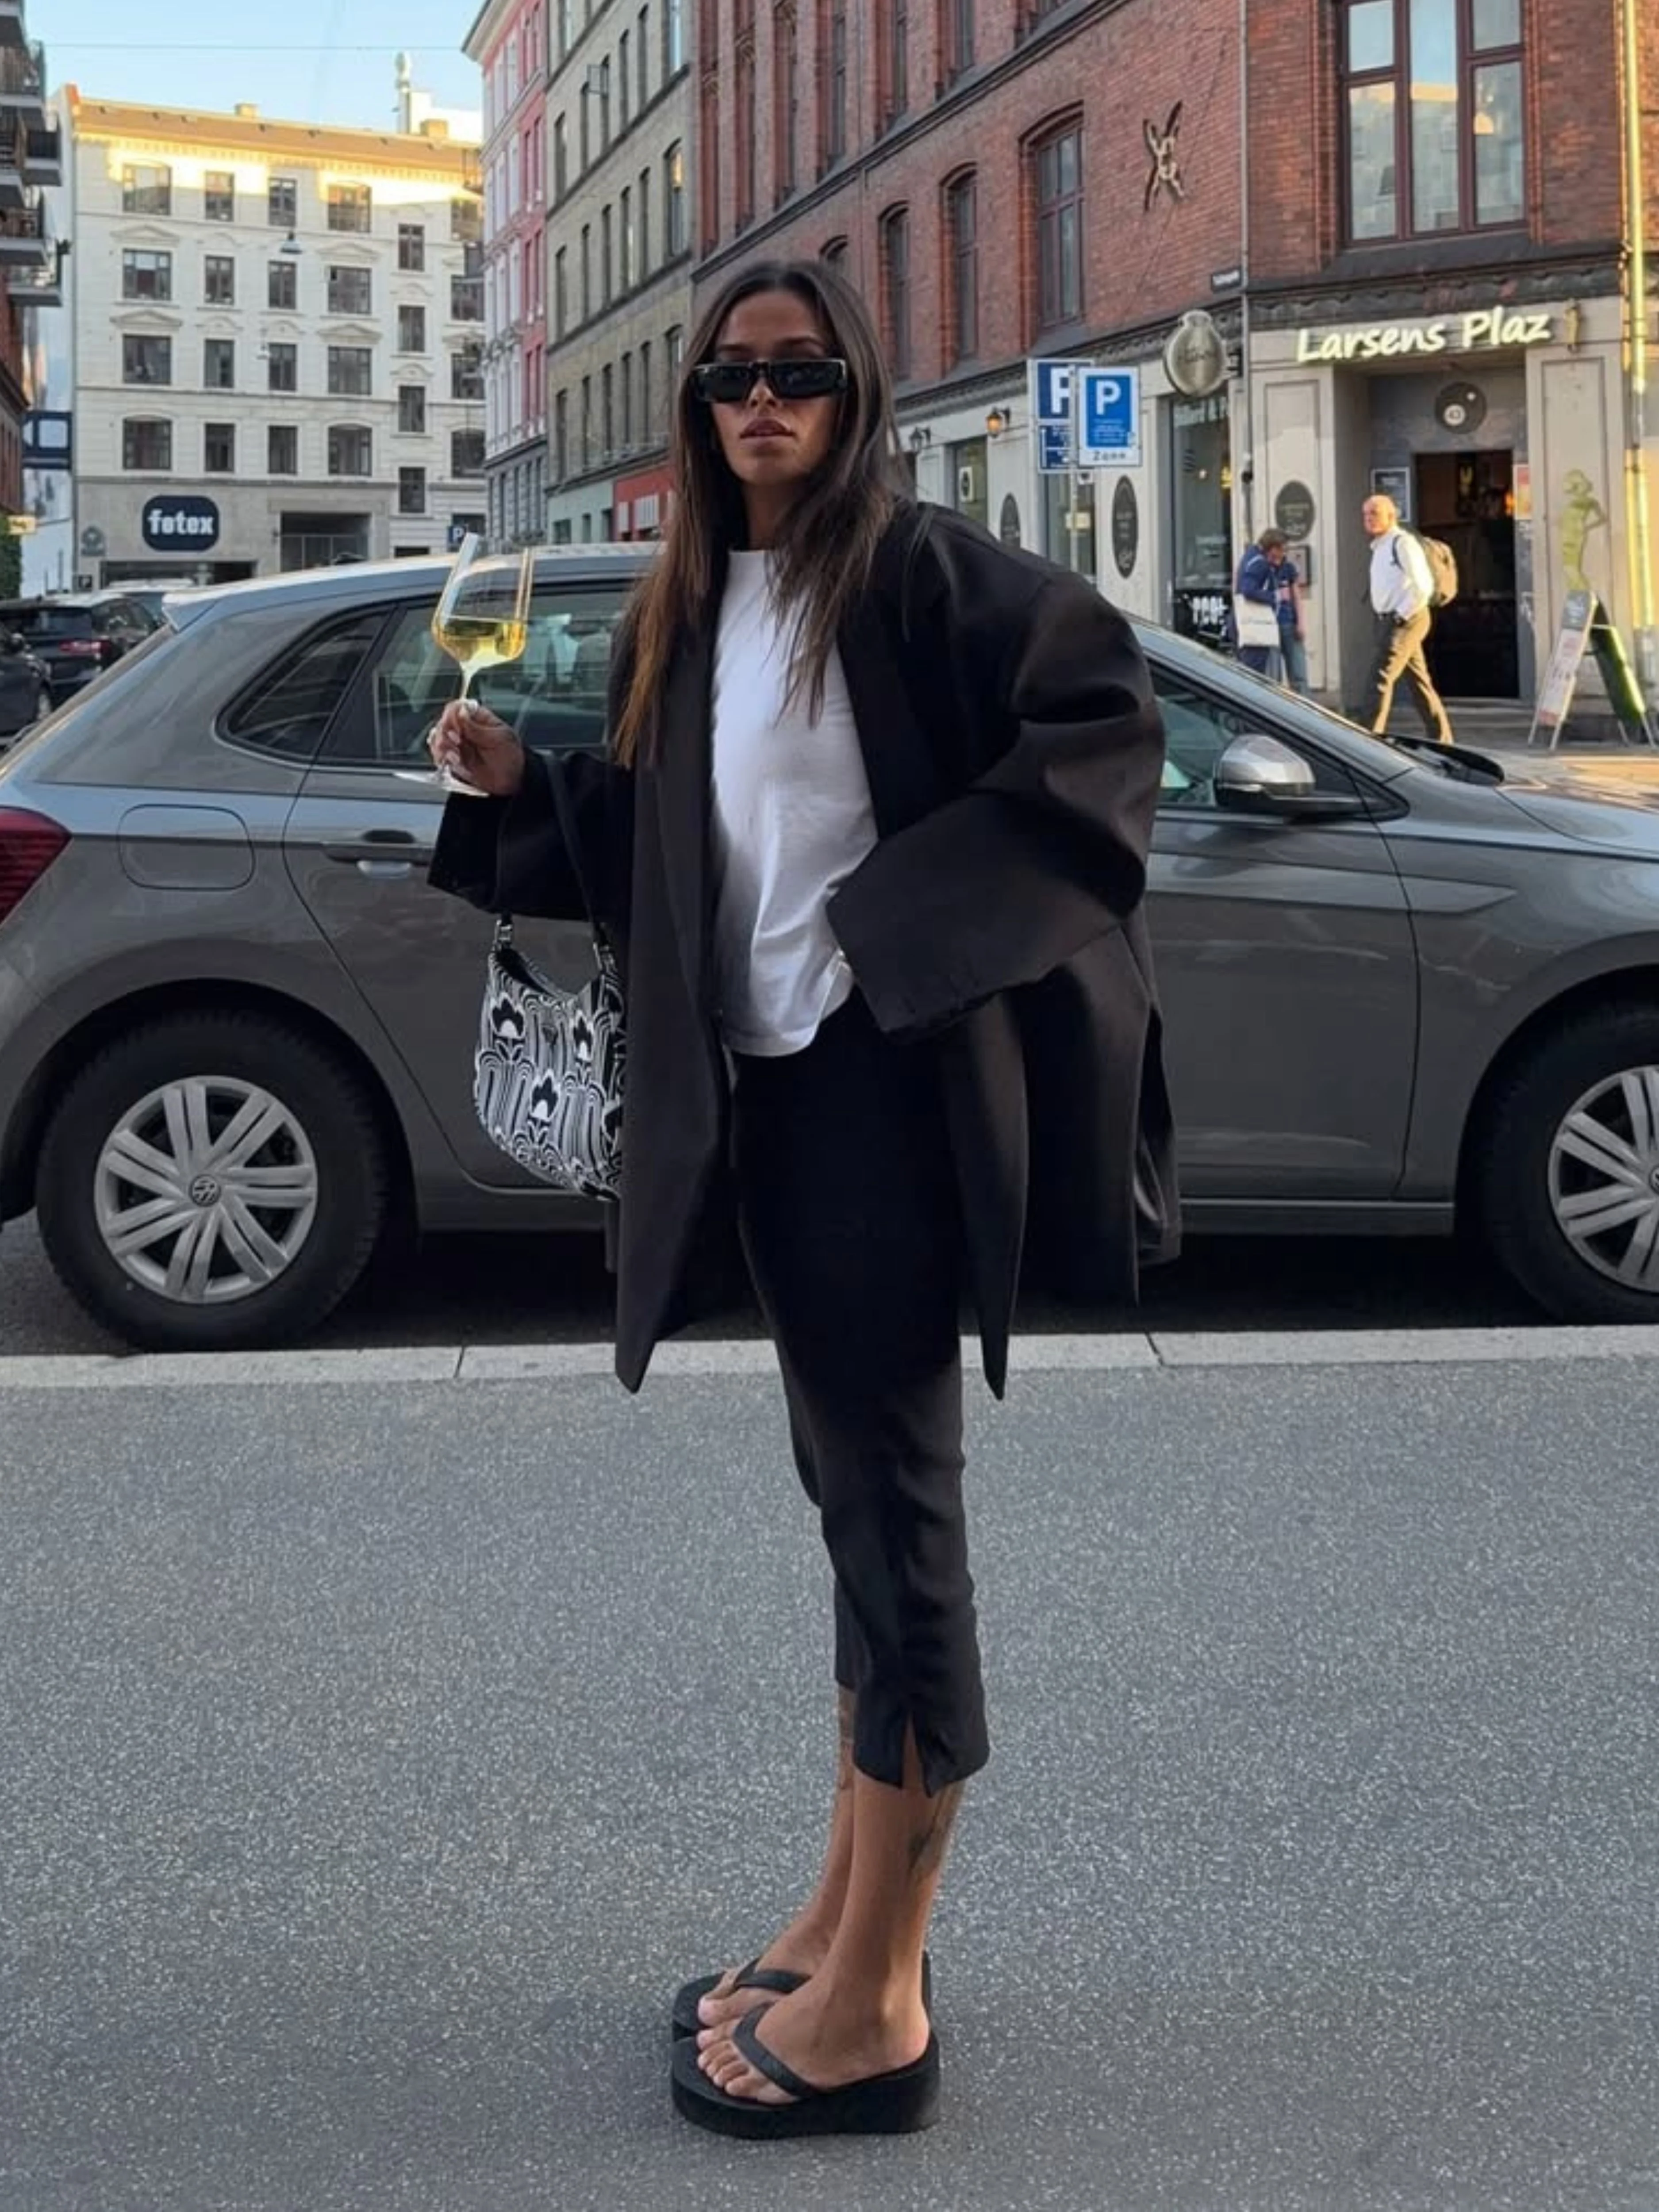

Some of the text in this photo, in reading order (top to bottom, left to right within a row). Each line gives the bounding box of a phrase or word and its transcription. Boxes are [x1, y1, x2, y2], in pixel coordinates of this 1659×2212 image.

[1298, 305, 1551, 361] Larsens Plaz
[1096, 380, 1121, 415] P
